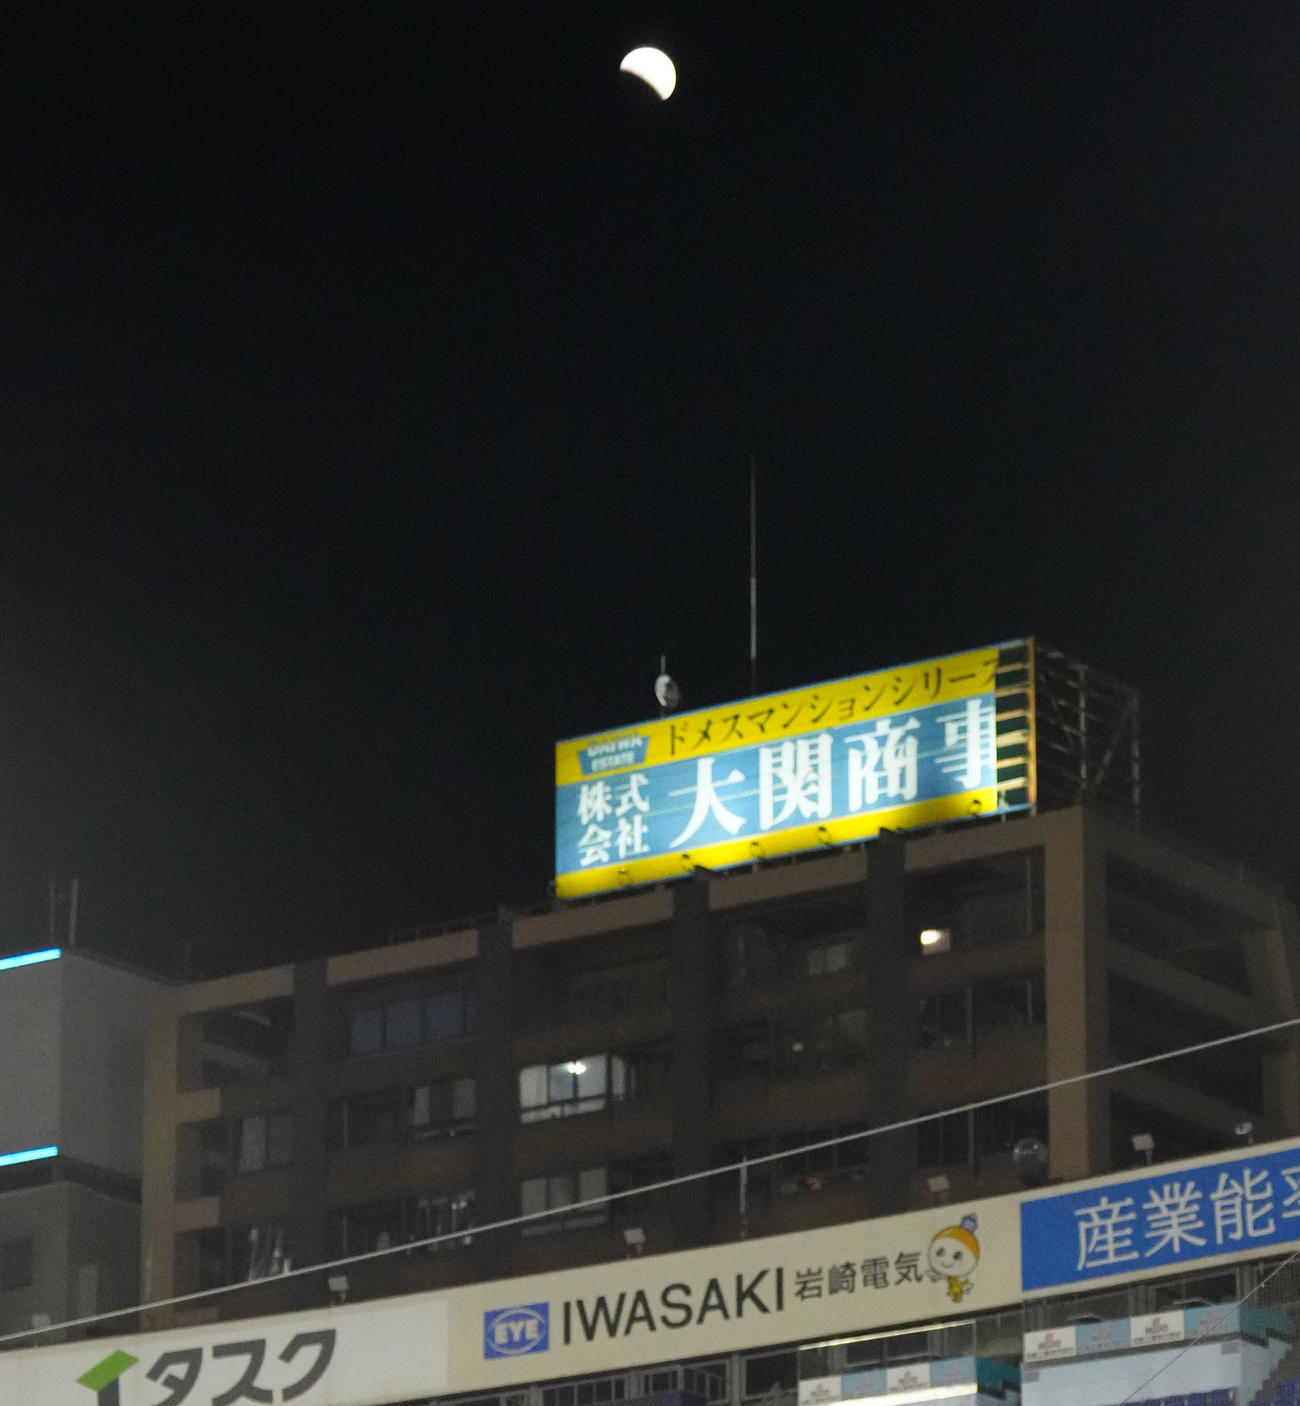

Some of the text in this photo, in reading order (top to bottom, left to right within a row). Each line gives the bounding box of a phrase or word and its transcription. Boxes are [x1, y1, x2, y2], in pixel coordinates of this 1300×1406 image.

[577, 773, 650, 825] 株式
[669, 698, 997, 850] 大関商事
[577, 816, 650, 867] 会社
[563, 1250, 924, 1345] IWASAKI 岩崎電気
[493, 1316, 540, 1344] EYE
